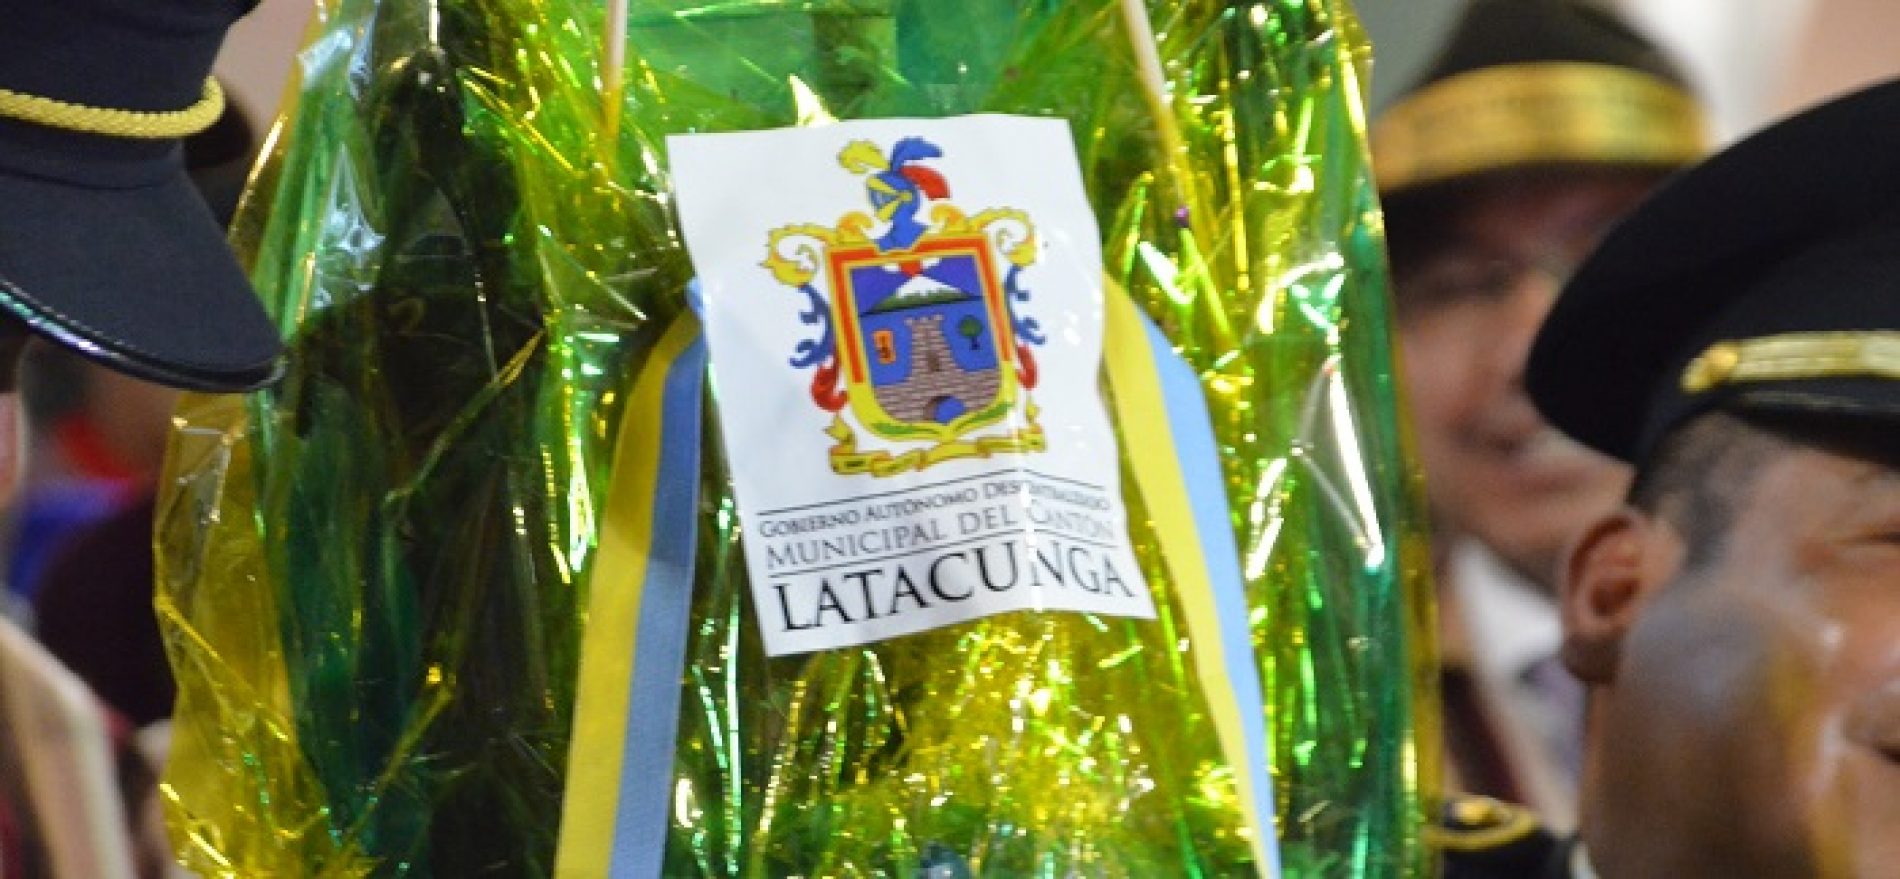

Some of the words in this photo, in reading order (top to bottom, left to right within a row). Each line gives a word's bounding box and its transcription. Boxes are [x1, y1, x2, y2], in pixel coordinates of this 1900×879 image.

[760, 509, 861, 537] GOBIERNO
[766, 518, 947, 569] MUNICIPAL
[958, 504, 1018, 535] DEL
[773, 540, 1135, 632] LATACUNGA
